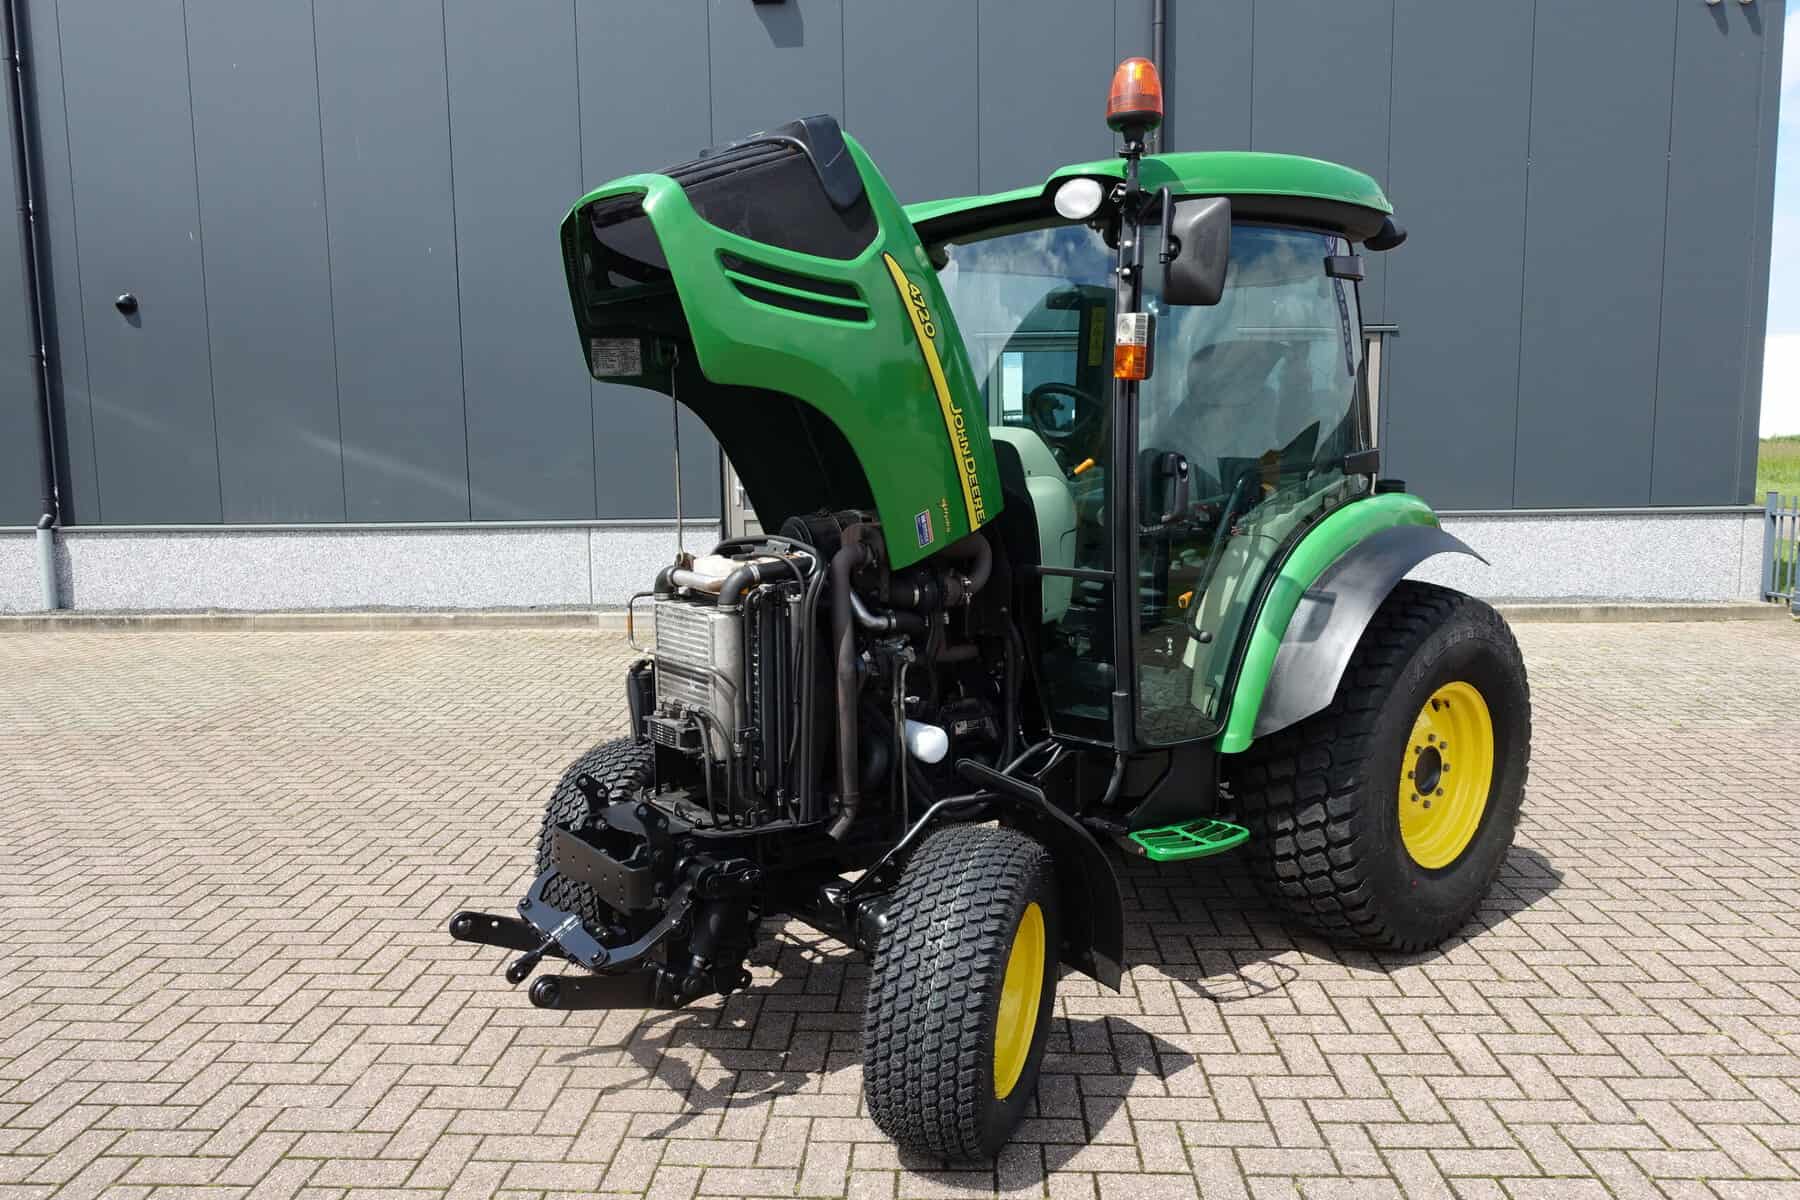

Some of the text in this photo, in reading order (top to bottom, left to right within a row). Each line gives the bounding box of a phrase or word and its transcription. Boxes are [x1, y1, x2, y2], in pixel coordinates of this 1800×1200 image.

[909, 282, 935, 338] 4720
[950, 401, 986, 523] JOHN DEERE
